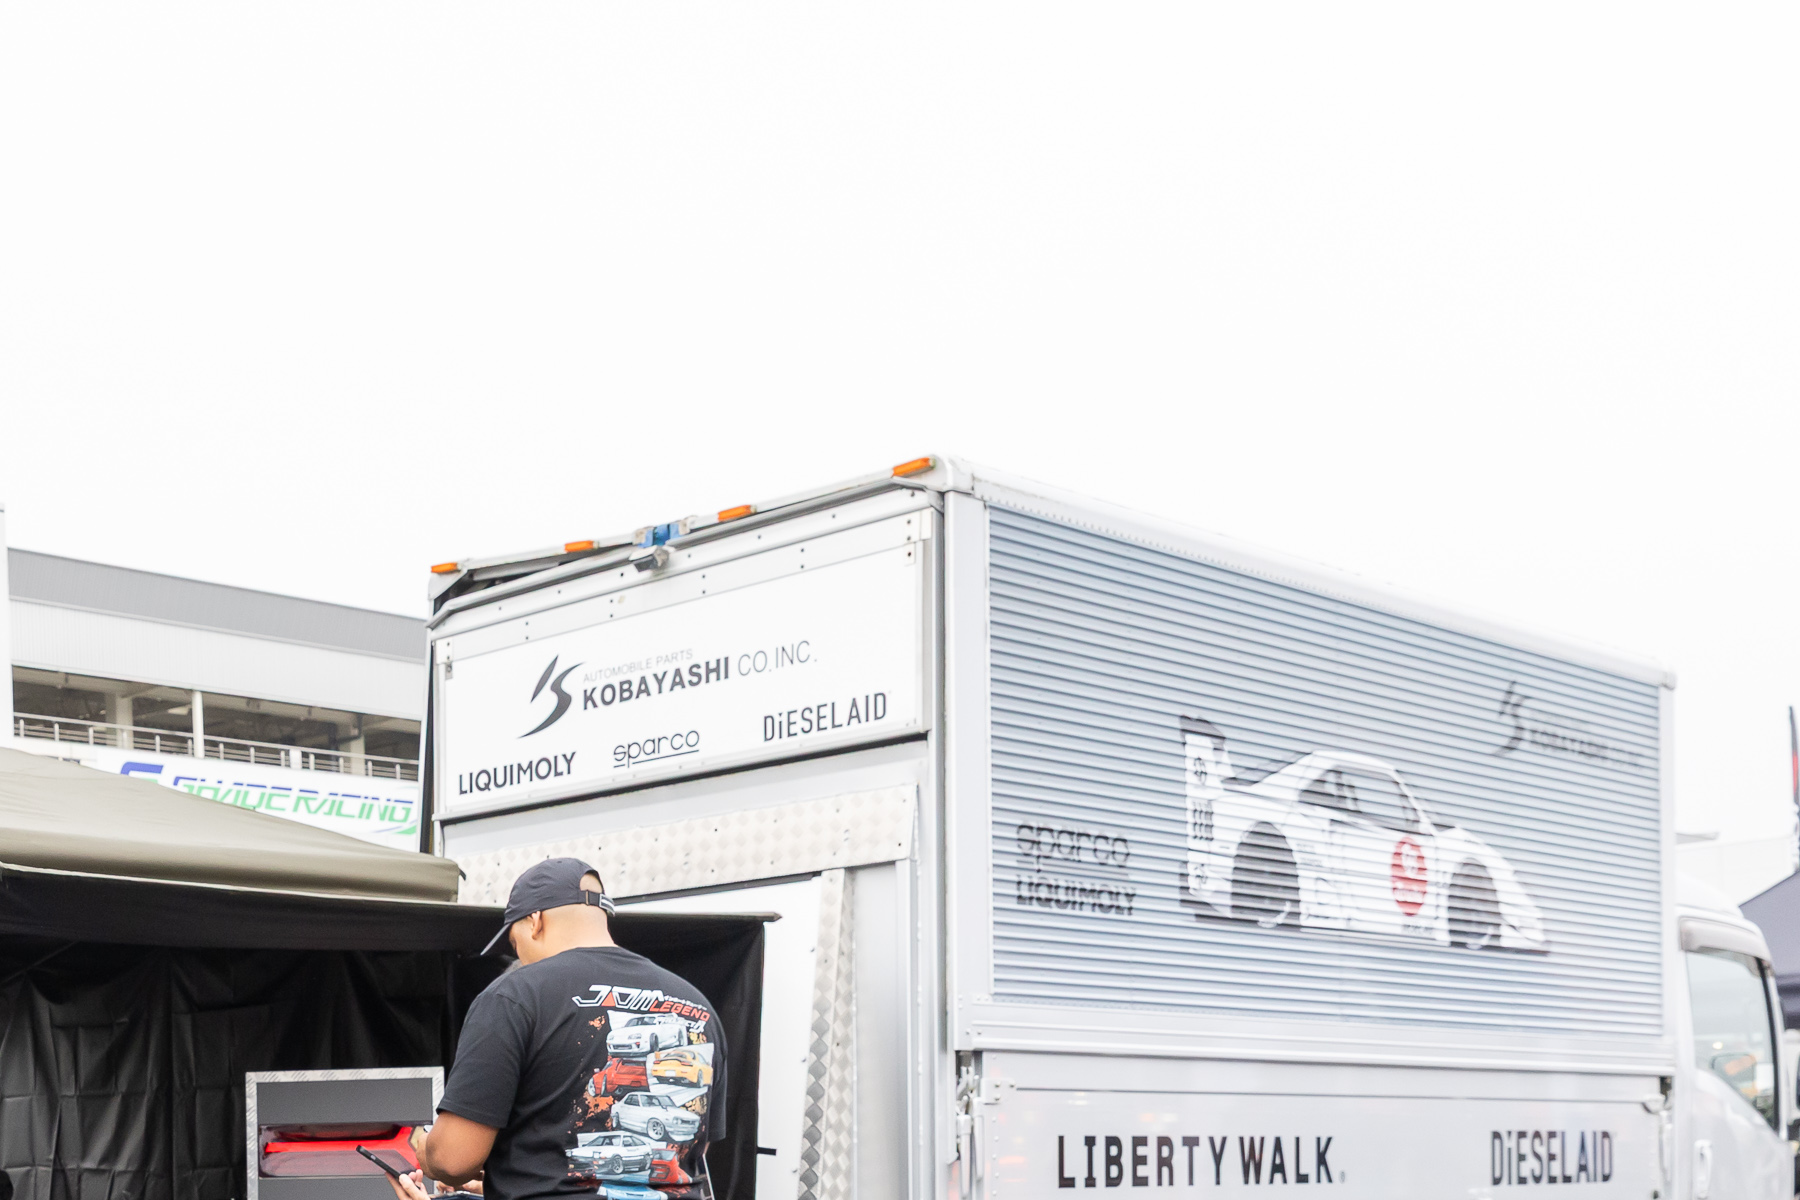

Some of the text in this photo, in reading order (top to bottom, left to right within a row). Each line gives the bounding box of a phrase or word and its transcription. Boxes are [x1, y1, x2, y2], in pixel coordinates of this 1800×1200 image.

[582, 656, 731, 710] KOBAYASHI
[583, 648, 694, 683] AUTOMOBILE PARTS
[613, 729, 700, 769] sparco
[292, 789, 414, 824] RACING
[649, 1000, 711, 1022] LEGEND
[1057, 1134, 1335, 1189] LIBERTY WALK
